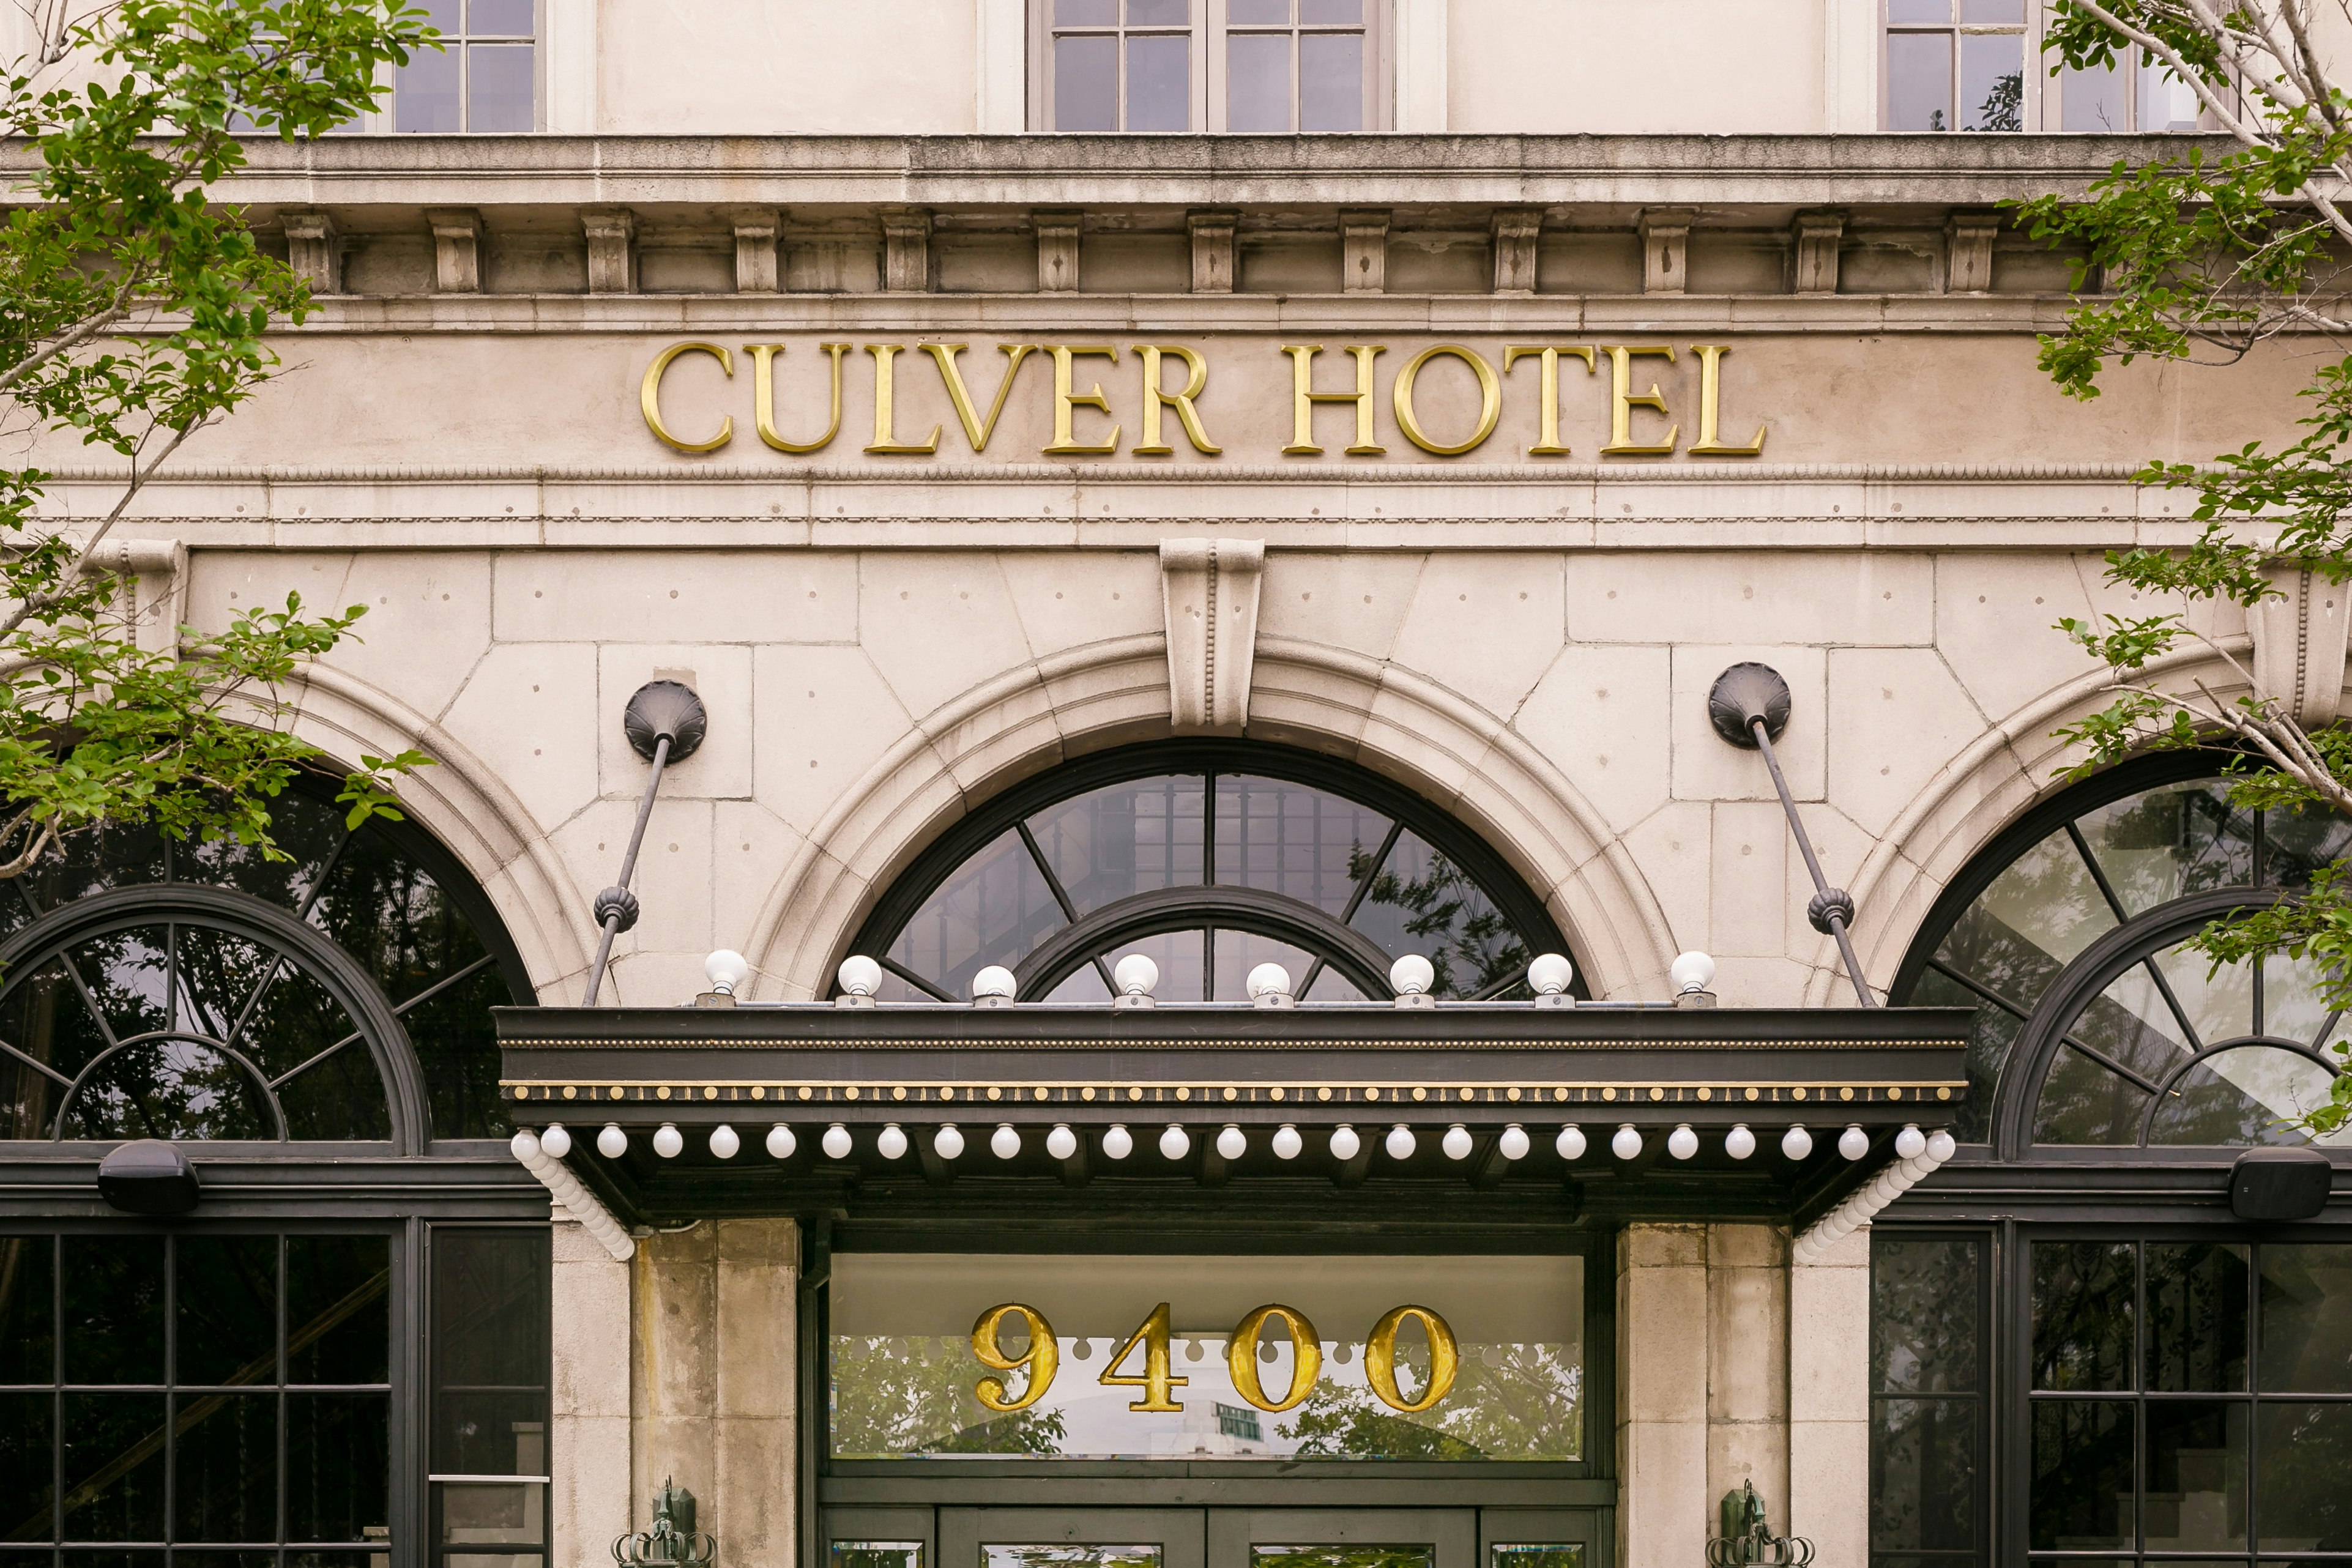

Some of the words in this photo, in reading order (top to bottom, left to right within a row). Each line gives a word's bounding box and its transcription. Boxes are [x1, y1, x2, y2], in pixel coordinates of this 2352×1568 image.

[641, 341, 1223, 454] CULVER
[1281, 343, 1766, 454] HOTEL
[971, 1302, 1459, 1412] 9400
